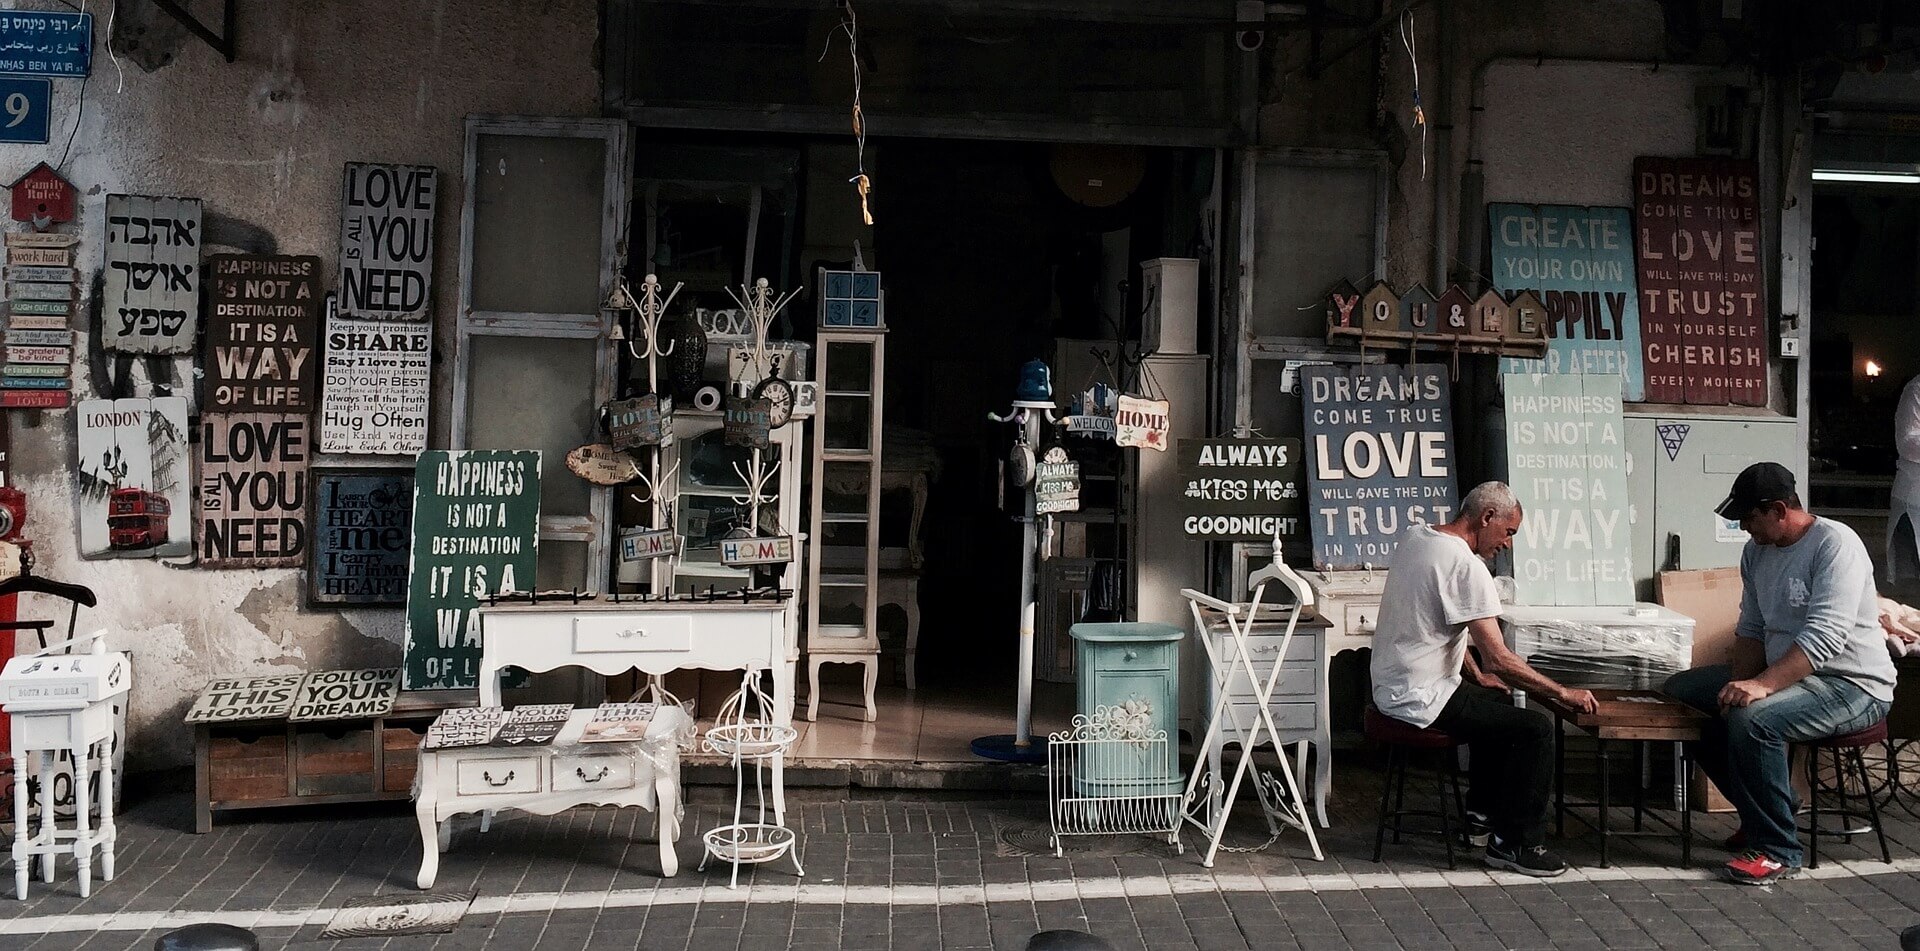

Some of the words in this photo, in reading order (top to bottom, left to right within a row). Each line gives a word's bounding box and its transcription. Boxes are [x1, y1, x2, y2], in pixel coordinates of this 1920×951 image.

[29, 61, 47, 70] BEN
[5, 92, 30, 128] 9
[24, 179, 64, 192] Family
[27, 189, 61, 201] Rules
[349, 168, 432, 210] LOVE
[1641, 172, 1752, 198] DREAMS
[1642, 203, 1693, 218] COME
[1704, 206, 1752, 220] TRUE
[110, 216, 195, 246] אהבה
[347, 215, 363, 243] ALL
[367, 215, 430, 263] YOU
[1500, 216, 1619, 250] CREATE
[346, 247, 361, 260] IS
[1642, 228, 1756, 263] LOVE
[14, 251, 40, 262] work
[41, 251, 65, 263] hard
[217, 259, 312, 275] HAPPINESS
[111, 260, 194, 292] אושר
[1504, 257, 1563, 280] YOUR
[1570, 259, 1623, 282] OWN
[1646, 270, 1672, 280] WILL
[1708, 272, 1729, 282] THE
[1733, 273, 1754, 283] DAY
[245, 280, 291, 299] NOT
[296, 281, 312, 299] A
[341, 267, 426, 312] NEED
[34, 304, 48, 312] OUT
[50, 304, 68, 312] LOUD
[1332, 294, 1428, 328] YOU
[1449, 304, 1465, 328] &
[1483, 305, 1536, 332] ME
[1644, 289, 1757, 317] TRUST
[118, 307, 187, 336] שפע
[330, 322, 354, 332] Keep
[357, 325, 380, 333] your
[383, 325, 429, 334] promises
[1648, 322, 1663, 333] IN
[1673, 323, 1757, 337] YOURSELF
[230, 323, 251, 341] IT
[256, 323, 278, 342] IS
[282, 324, 299, 342] A
[329, 333, 428, 352] SHARE
[215, 346, 312, 380] WAY
[328, 357, 355, 367] Say
[358, 357, 366, 366] I
[368, 357, 397, 367] love
[400, 360, 427, 369] you
[1647, 343, 1761, 367] CHERISH
[326, 376, 346, 386] DO
[350, 376, 387, 386] YOUR
[392, 377, 427, 387] BEST
[1311, 375, 1441, 403] DREAMS
[1650, 375, 1695, 387] EVERY
[1703, 376, 1762, 388] MOMENT
[16, 397, 53, 406] LOVED
[215, 386, 246, 405] OF
[326, 394, 360, 404] Always
[363, 395, 379, 403] Tell
[382, 395, 397, 403] the
[402, 395, 425, 404] Truth
[1512, 395, 1615, 414] HAPPINESS
[326, 403, 359, 412] Laugh
[378, 403, 424, 412] Yourself
[1313, 409, 1373, 424] COME
[1386, 408, 1442, 423] TRUE
[86, 411, 141, 428] LONDON
[325, 411, 363, 431] Hug
[372, 411, 424, 427] Often
[611, 408, 656, 428] LOVE
[1118, 410, 1168, 431] HOME
[205, 422, 304, 463] LOVE
[324, 431, 345, 439] Use
[389, 432, 424, 440] Words
[1513, 421, 1536, 445] IS
[1543, 422, 1594, 445] NOT
[1601, 422, 1618, 445] A
[325, 440, 353, 450] Love
[360, 441, 386, 450] Each
[393, 441, 423, 451] Other
[1315, 430, 1449, 480] LOVE
[1198, 445, 1287, 467] ALWAYS
[597, 462, 617, 471] Sweet
[1041, 463, 1075, 476] ALWAYS
[204, 473, 222, 496] ALL
[436, 460, 525, 497] HAPPINESS
[1533, 477, 1554, 500] IT
[1561, 476, 1584, 501] IS
[1590, 477, 1607, 500] A
[222, 471, 304, 512] YOU
[326, 481, 341, 509] I
[1200, 478, 1248, 500] KISS
[1321, 488, 1353, 500] WILL
[1395, 486, 1419, 498] THE
[1423, 486, 1448, 498] DAY
[204, 499, 221, 511] IS
[448, 503, 460, 528] IS
[465, 504, 492, 528] NOT
[497, 502, 506, 528] A
[1036, 499, 1080, 513] GOODNIGHT
[326, 509, 412, 527] HEART
[1184, 516, 1298, 535] GOODNIGHT
[1319, 505, 1452, 536] TRUST
[204, 518, 305, 558] NEED
[1521, 508, 1620, 550] WAY
[432, 536, 521, 555] DESTINATION
[624, 533, 673, 558] HOME
[724, 540, 789, 561] HOME
[1325, 544, 1343, 557] IN
[324, 552, 339, 575] I
[340, 554, 384, 567] carry
[1524, 558, 1556, 582] OF
[324, 578, 408, 595] HEART
[430, 566, 453, 599] IT
[464, 564, 488, 600] IS
[499, 563, 516, 596] A
[436, 608, 483, 648] WA
[311, 669, 399, 685] FOLLOW
[425, 657, 454, 679] OF
[211, 676, 299, 691] BLESS
[307, 681, 393, 703] YOUR
[208, 688, 292, 708] THIS
[192, 704, 287, 719] HOME
[296, 699, 390, 718] DREAMS
